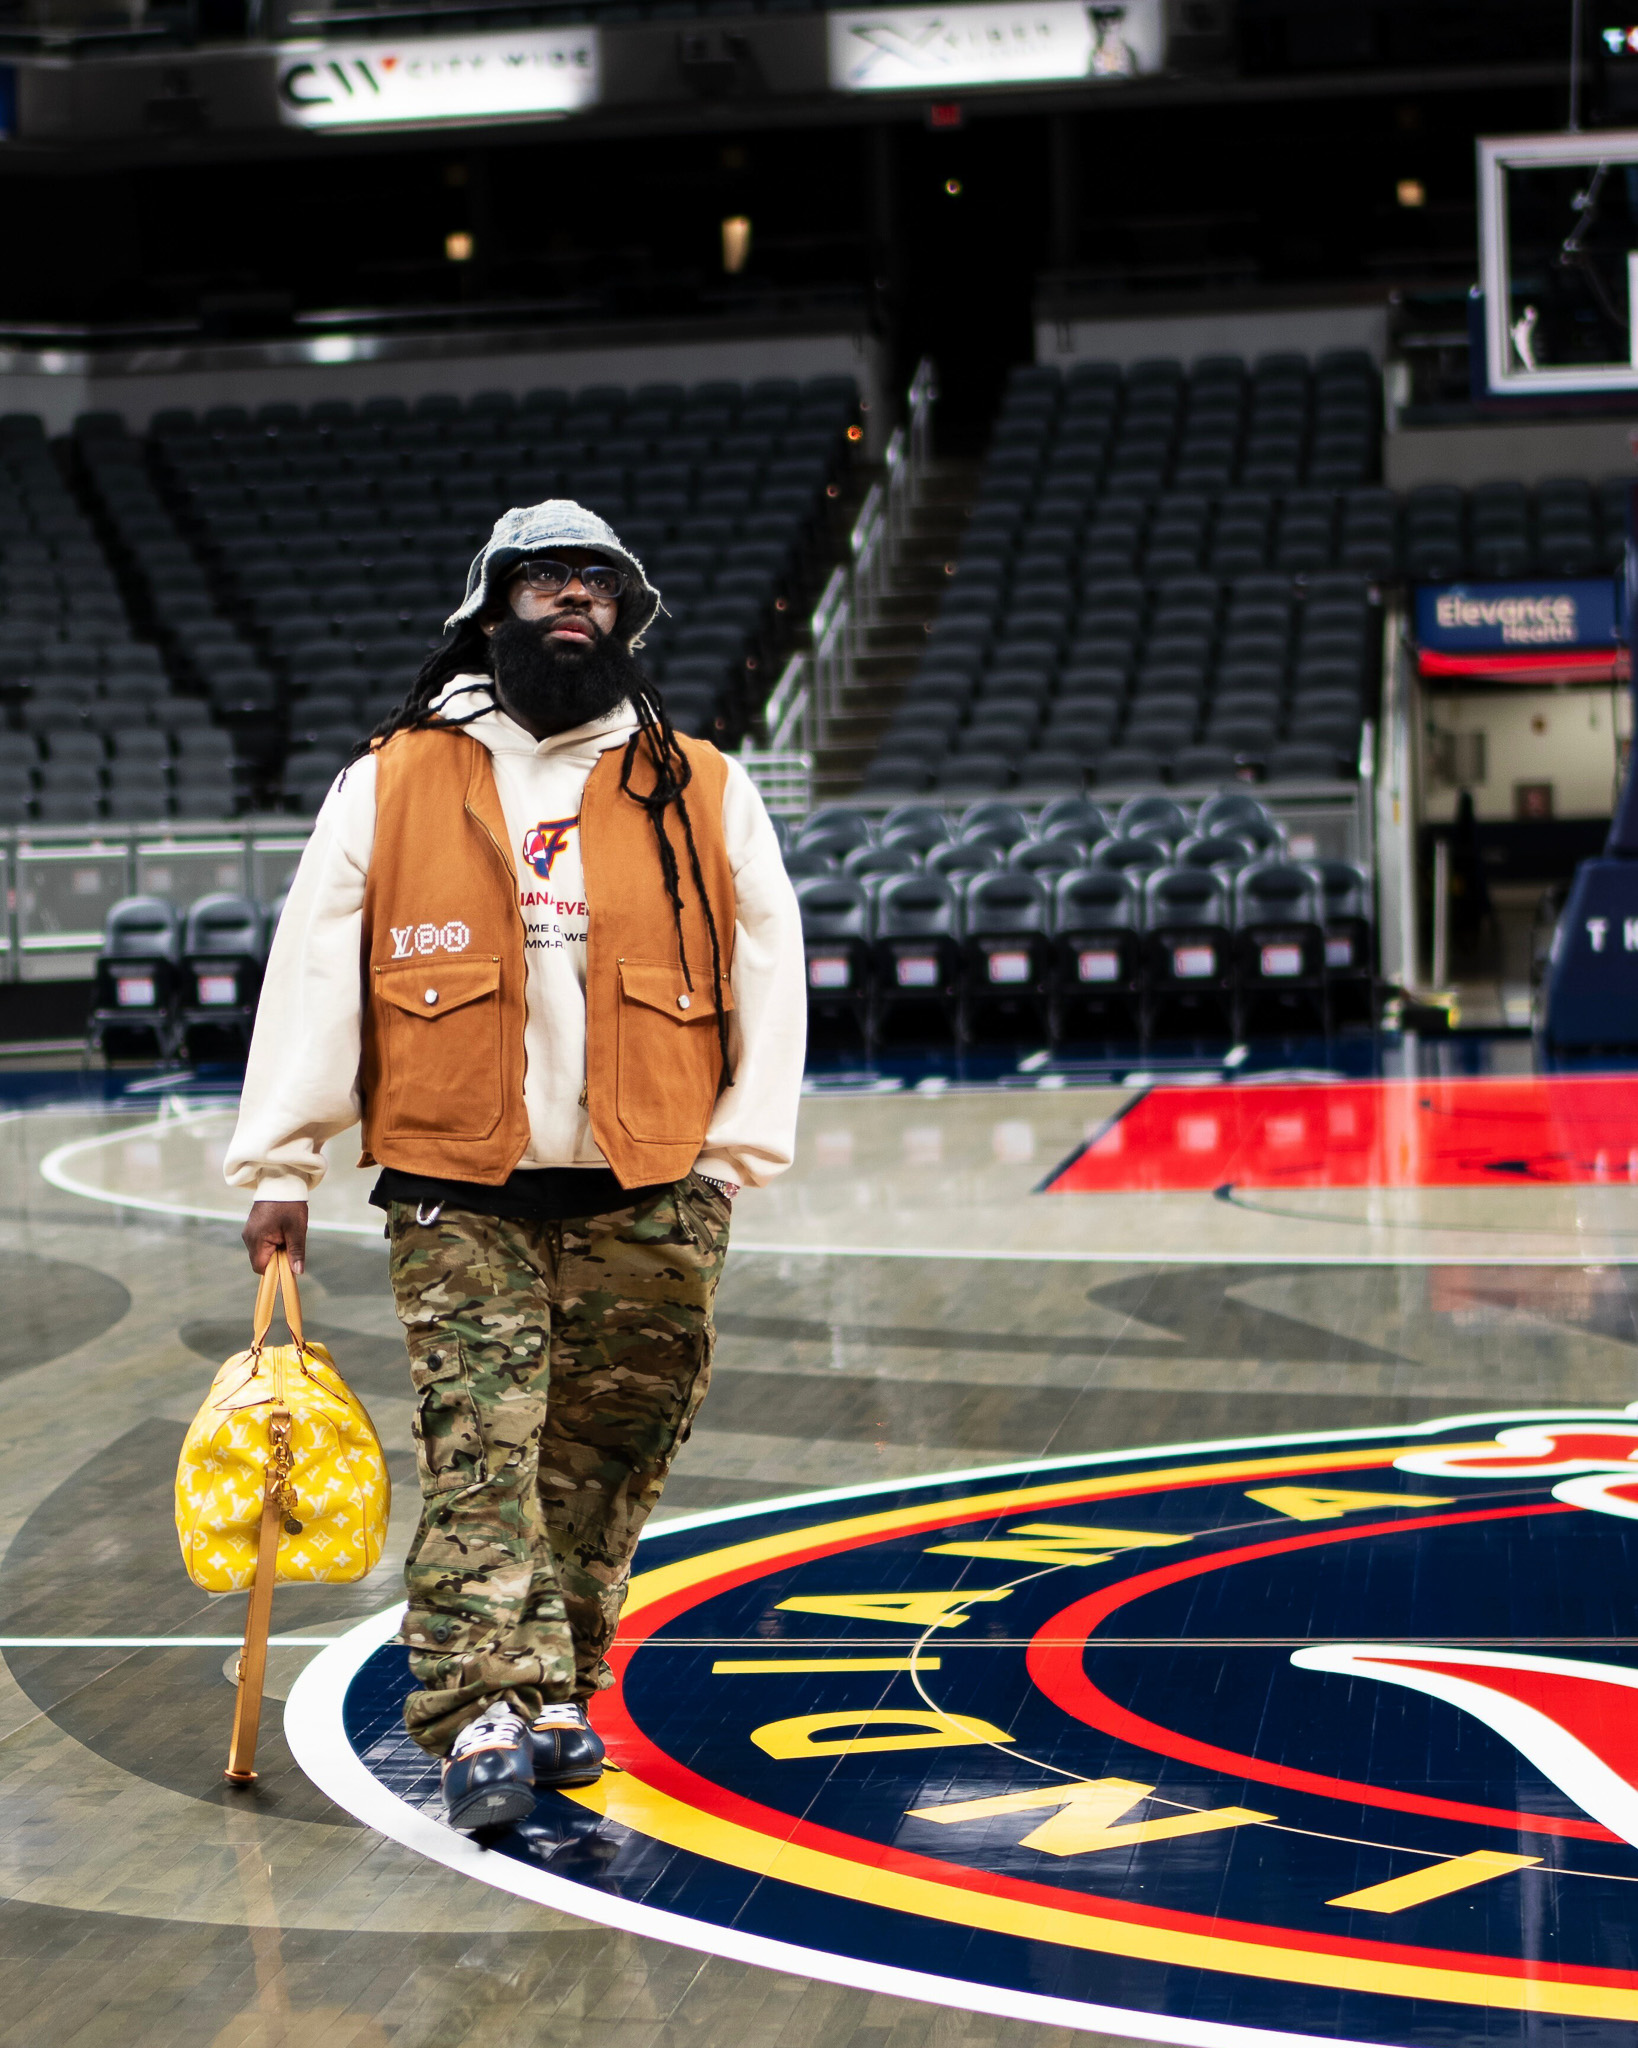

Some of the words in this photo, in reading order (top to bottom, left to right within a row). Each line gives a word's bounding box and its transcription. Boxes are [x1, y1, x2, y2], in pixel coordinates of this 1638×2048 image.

[502, 47, 590, 70] WIDE
[1436, 595, 1575, 628] Elevance
[711, 1486, 1544, 1914] INDIANA
